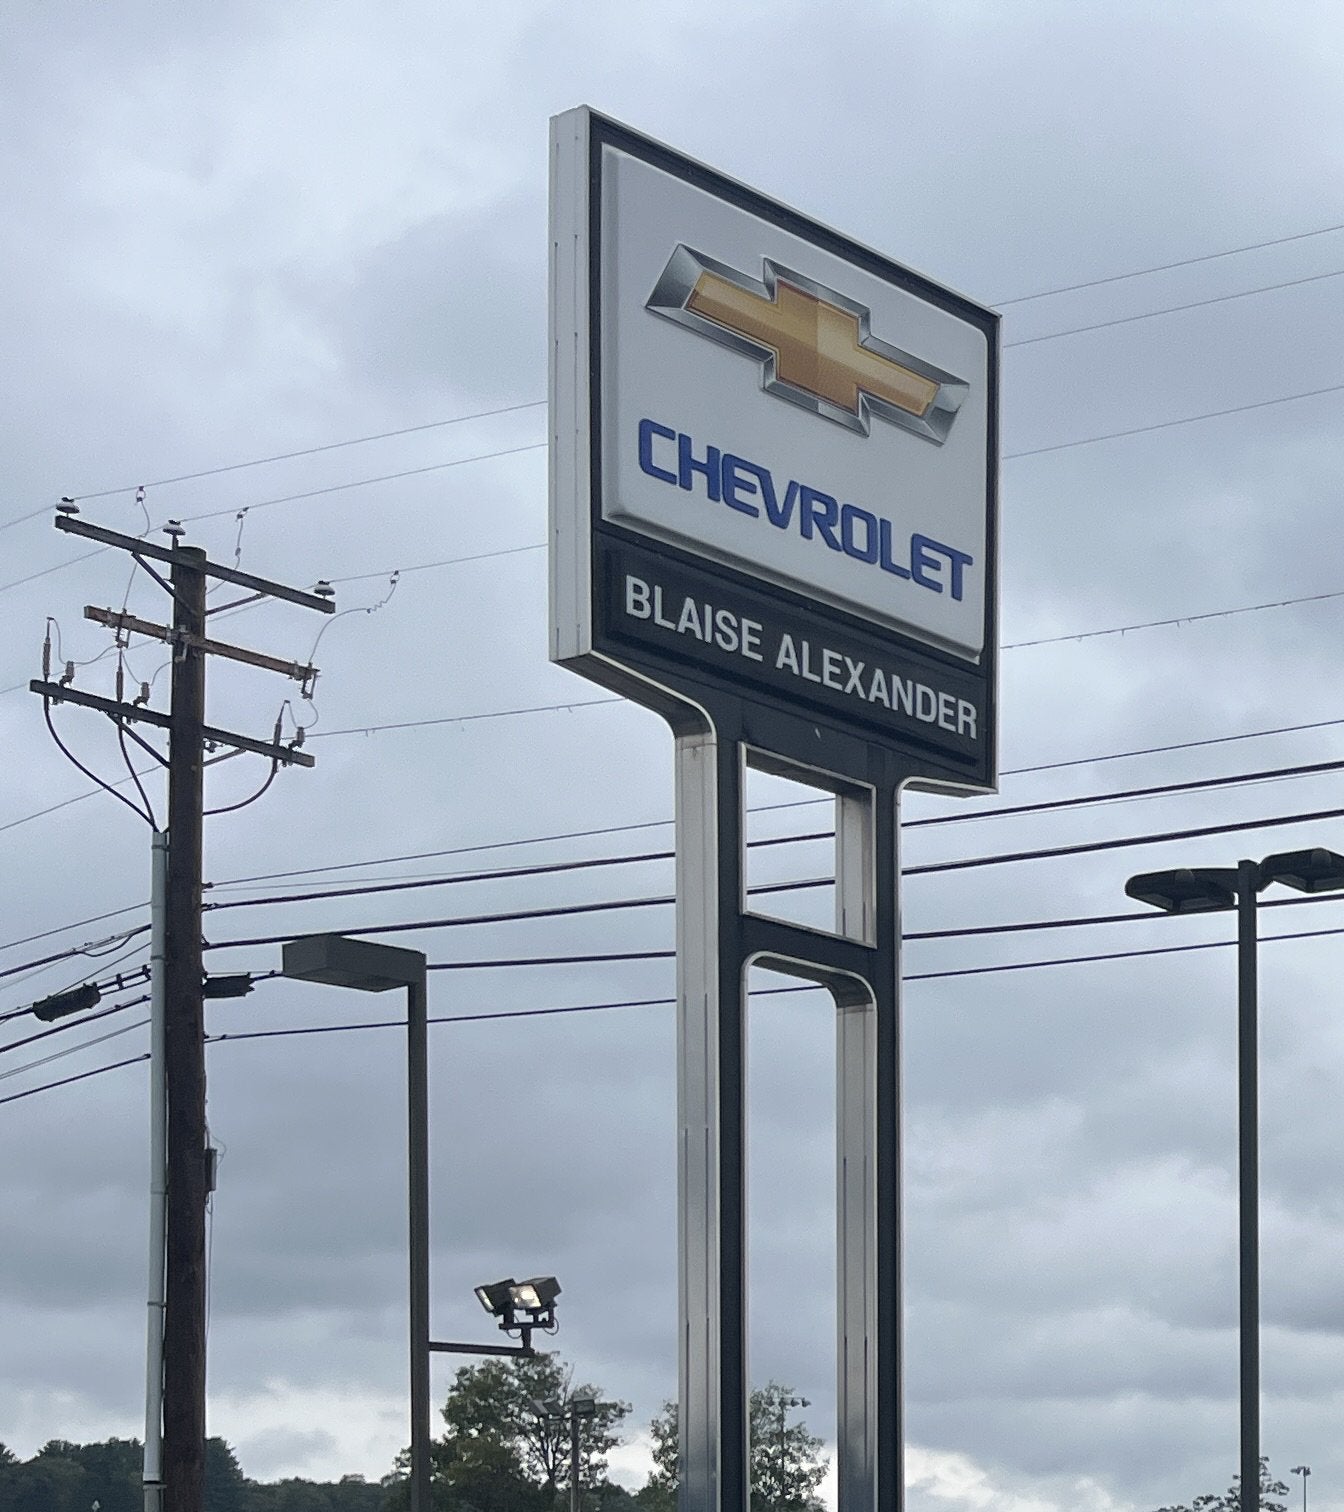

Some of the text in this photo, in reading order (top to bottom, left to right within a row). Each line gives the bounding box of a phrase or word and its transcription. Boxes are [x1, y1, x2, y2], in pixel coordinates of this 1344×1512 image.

[638, 418, 973, 601] CHEVROLET
[625, 574, 977, 741] BLAISE ALEXANDER
